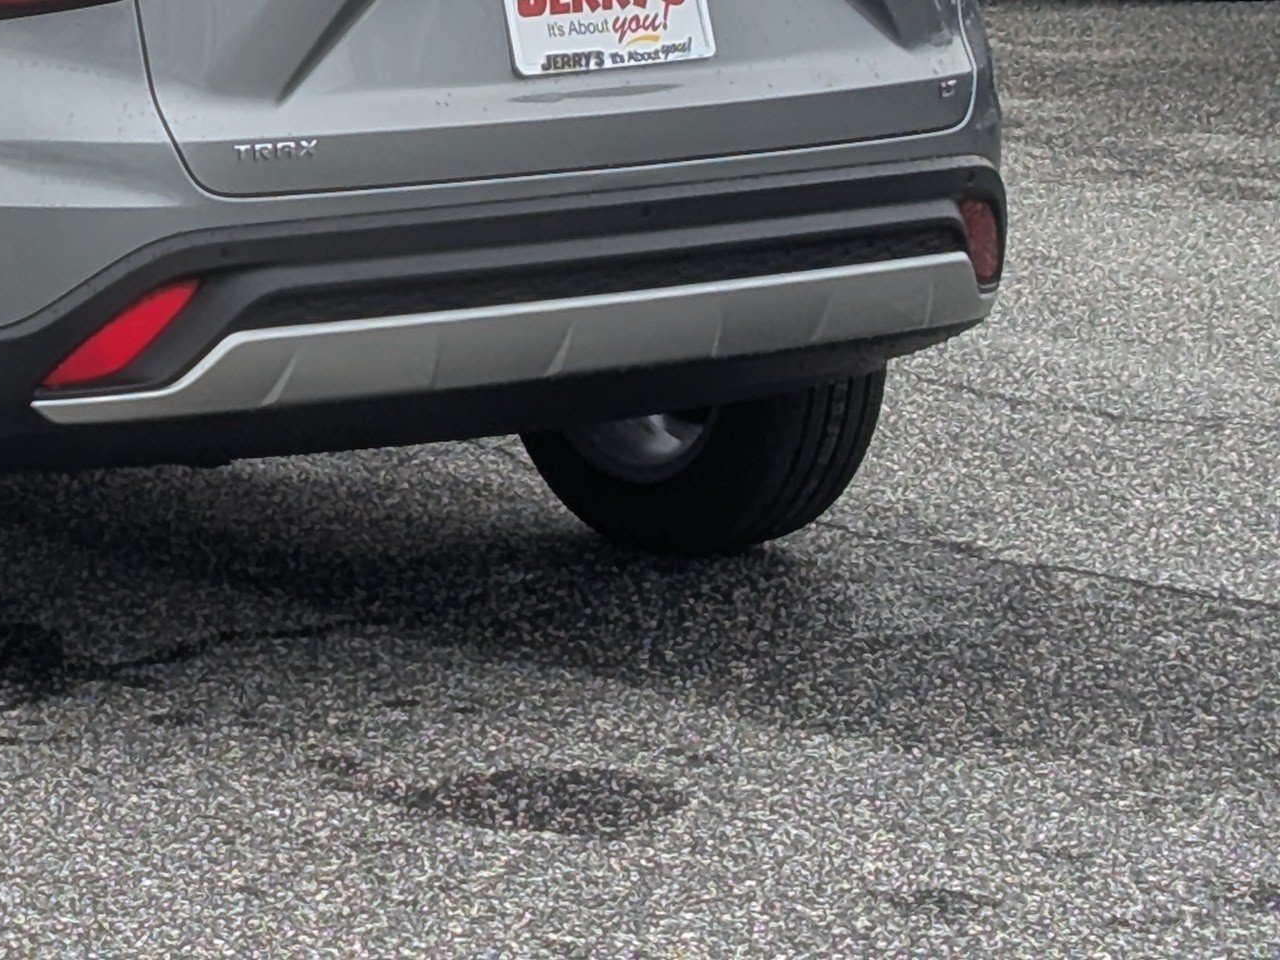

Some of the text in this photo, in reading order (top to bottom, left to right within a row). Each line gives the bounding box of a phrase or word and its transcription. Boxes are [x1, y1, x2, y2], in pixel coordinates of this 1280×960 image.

[547, 1, 669, 44] It's About you!
[541, 50, 605, 72] JERRY'S
[627, 49, 661, 63] About
[233, 139, 318, 161] TRAX
